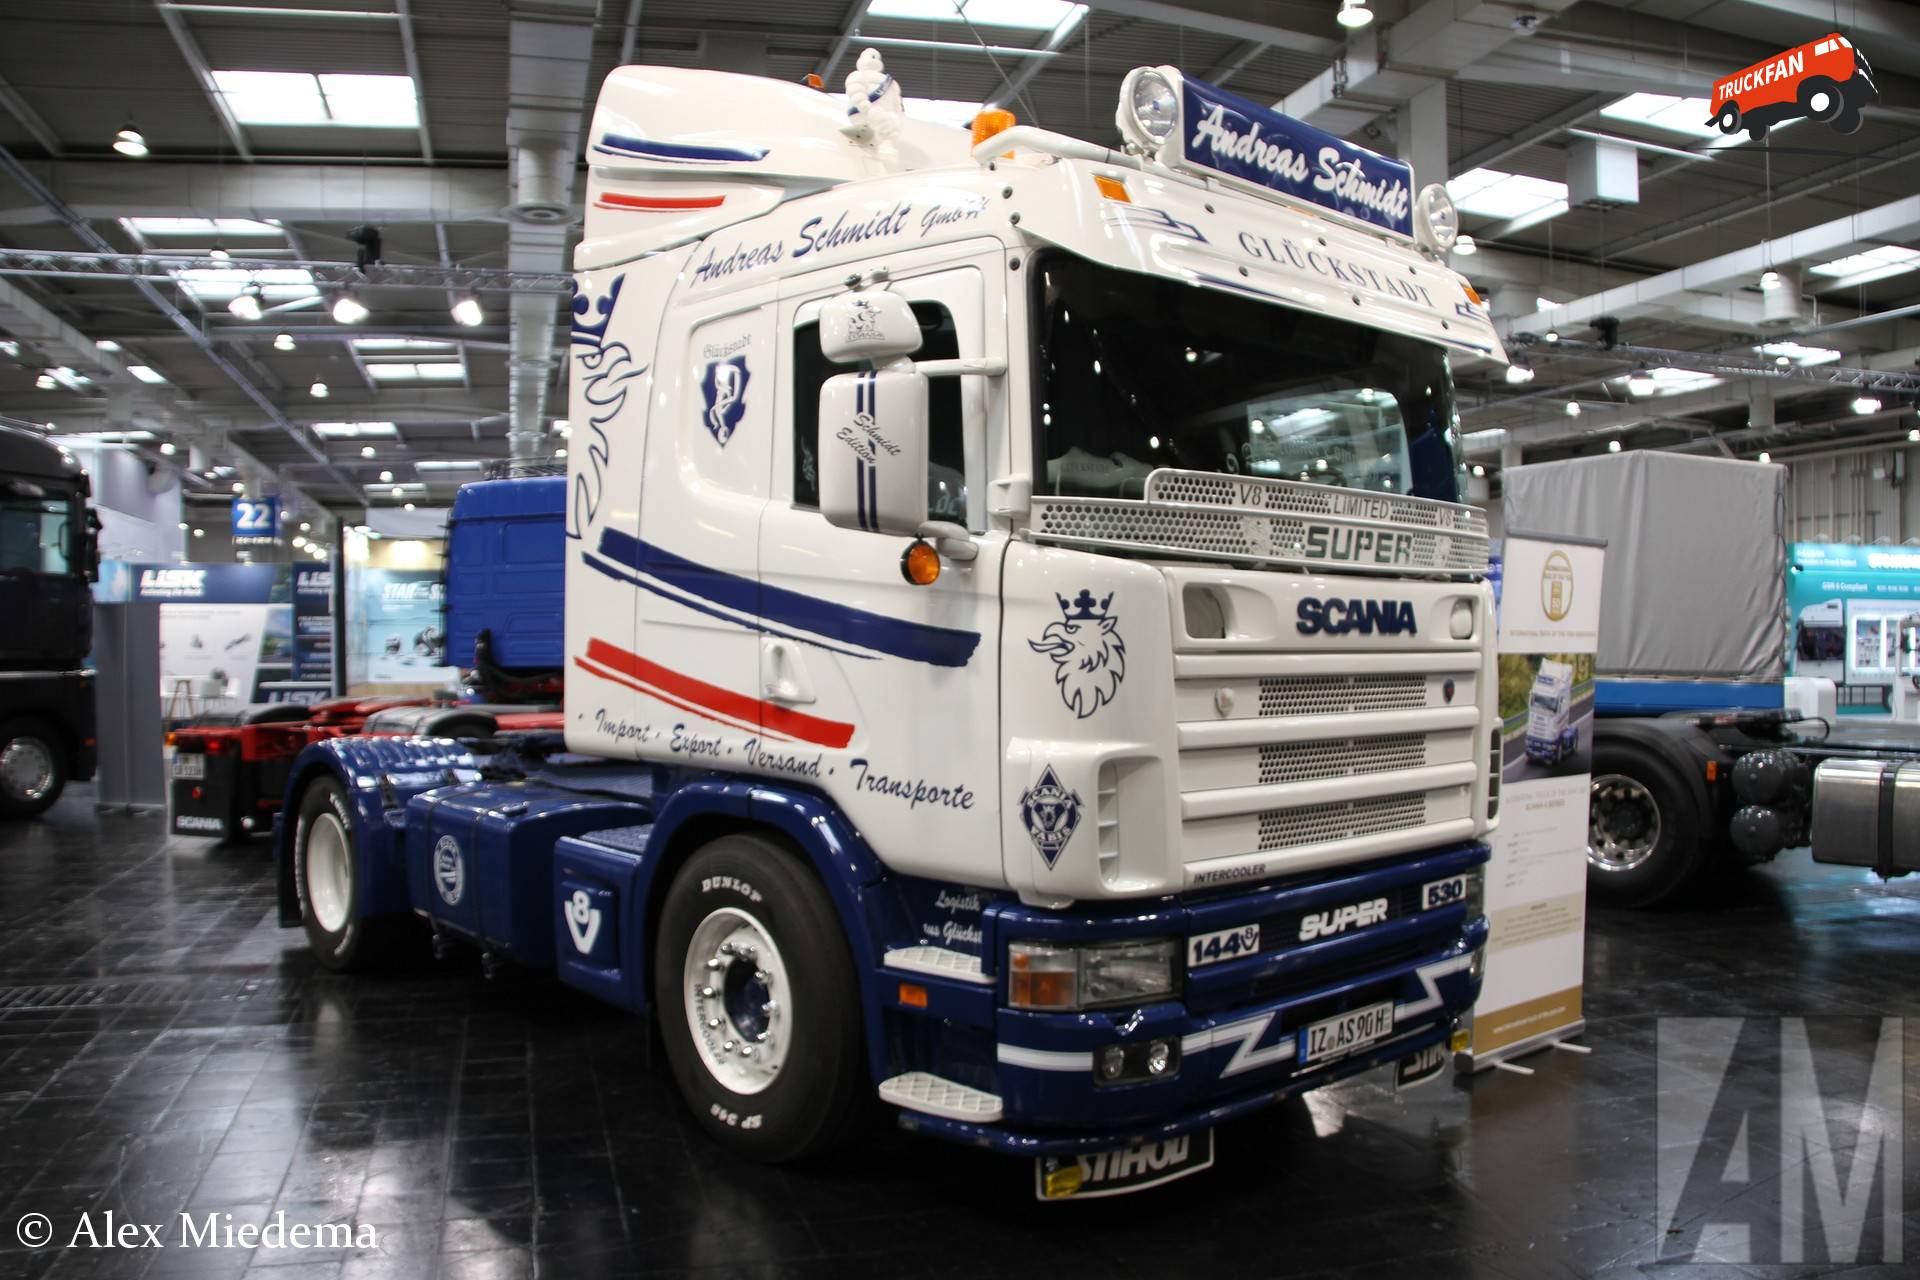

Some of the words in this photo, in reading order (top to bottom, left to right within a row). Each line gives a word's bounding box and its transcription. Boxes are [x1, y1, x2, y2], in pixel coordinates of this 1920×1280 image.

[1193, 104, 1308, 180] Andreas
[1313, 146, 1408, 218] Schmidt
[689, 240, 783, 288] Andreas
[792, 202, 911, 258] Schmidt
[1238, 231, 1434, 308] GLÜCKSTADT
[836, 427, 876, 464] Edition
[854, 412, 901, 456] Schmidt
[236, 503, 272, 529] 22
[1240, 485, 1262, 506] V8
[1333, 495, 1389, 520] LIMITED
[1439, 509, 1452, 527] V8
[1305, 525, 1413, 564] SUPER
[1296, 596, 1418, 637] SCANIA
[595, 709, 650, 743] Import
[669, 723, 722, 757] Export
[743, 738, 823, 779] Versand
[849, 758, 975, 810] Transporte
[176, 815, 224, 829] SCANIA
[702, 875, 762, 902] DUNLOP
[1194, 863, 1266, 884] INTERCOOLER
[1428, 879, 1462, 906] 530
[1299, 898, 1389, 941] SUPER
[1193, 934, 1241, 963] 144
[1310, 1026, 1327, 1056] IZ
[1336, 1018, 1355, 1048] AS
